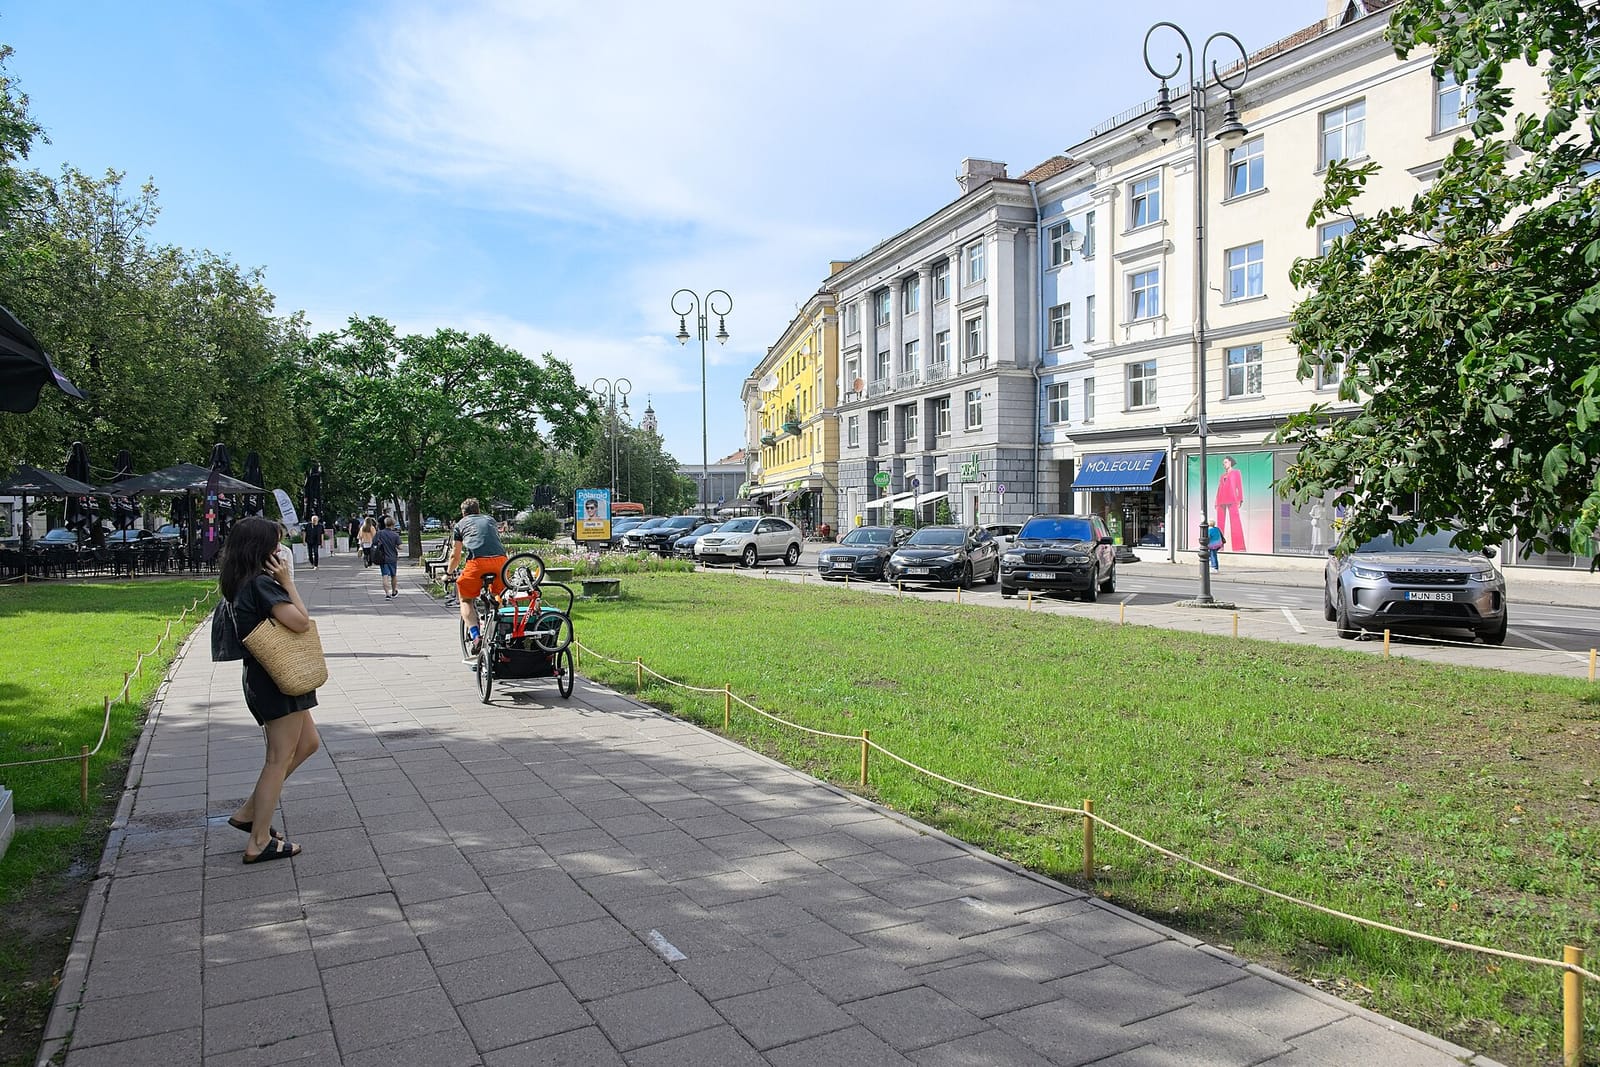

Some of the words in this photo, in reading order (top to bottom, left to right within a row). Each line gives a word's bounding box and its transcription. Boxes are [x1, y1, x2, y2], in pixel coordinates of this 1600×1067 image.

[578, 491, 608, 499] Polaroid
[1411, 592, 1430, 600] MJN
[1435, 593, 1452, 601] 853
